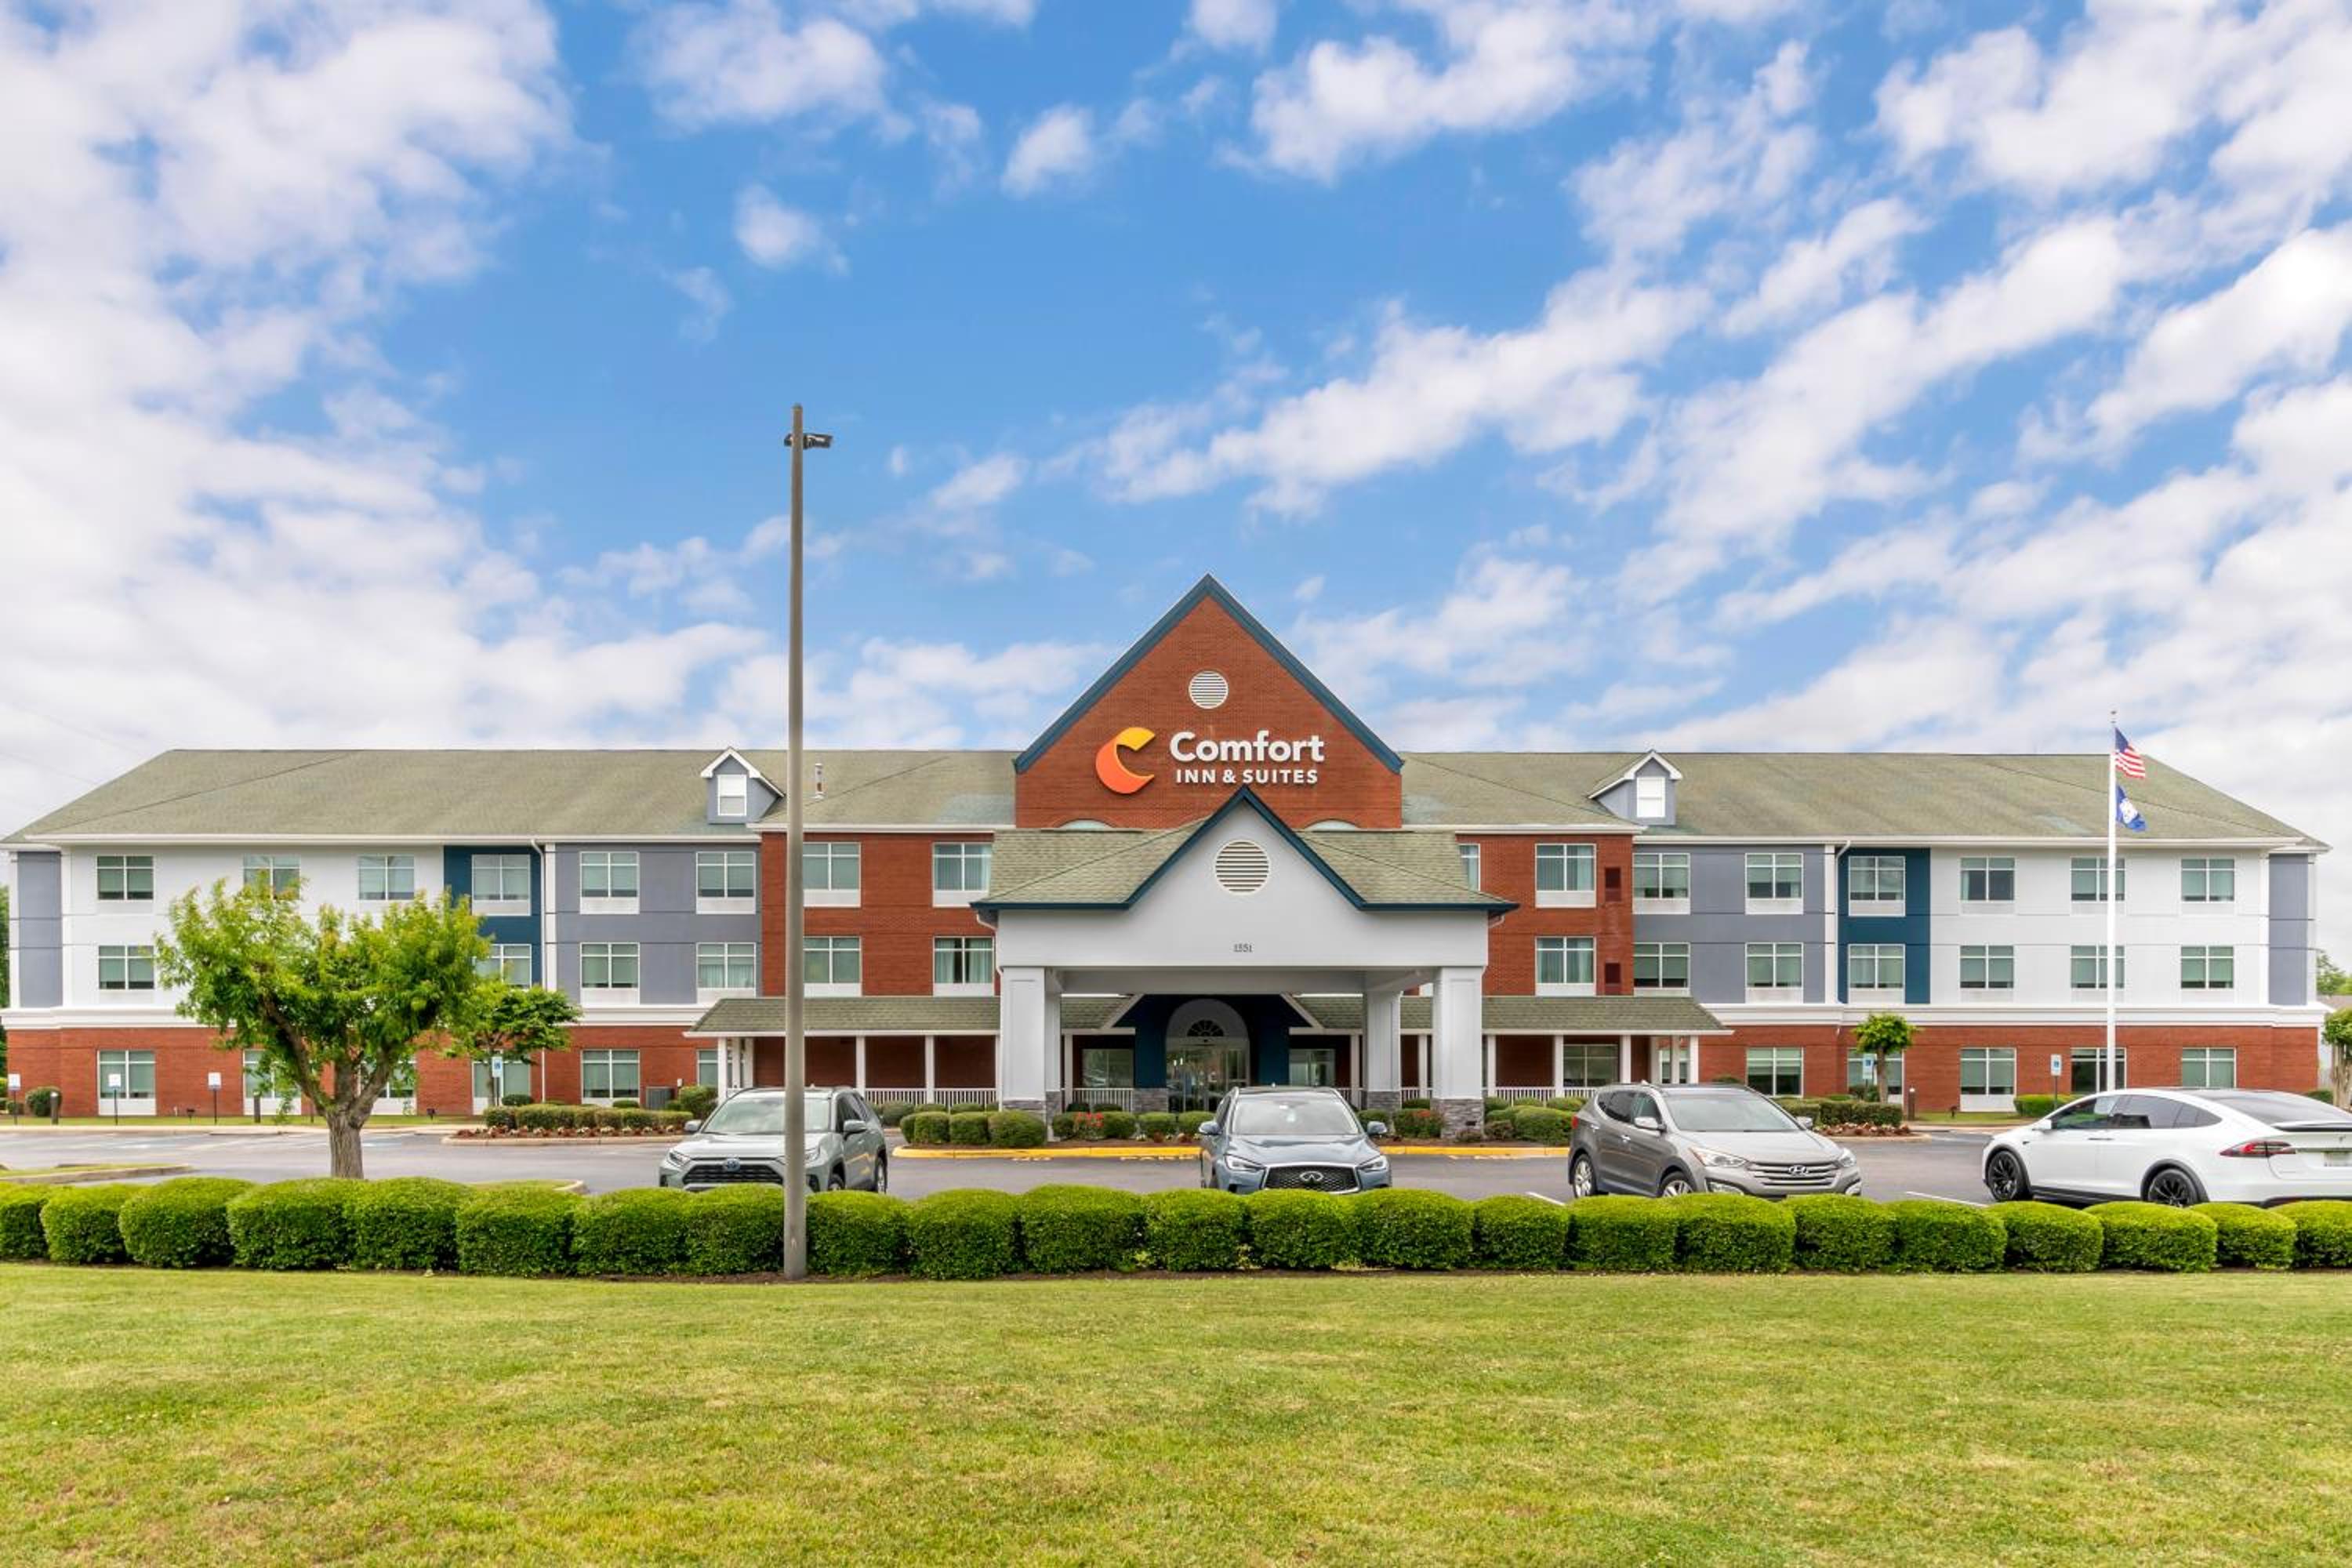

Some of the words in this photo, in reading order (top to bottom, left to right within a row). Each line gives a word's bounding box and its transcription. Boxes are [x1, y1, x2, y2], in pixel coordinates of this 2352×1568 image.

[1170, 730, 1325, 762] Comfort
[1176, 769, 1215, 783] INN
[1222, 769, 1236, 783] &
[1243, 769, 1318, 783] SUITES
[1233, 943, 1252, 953] 1551
